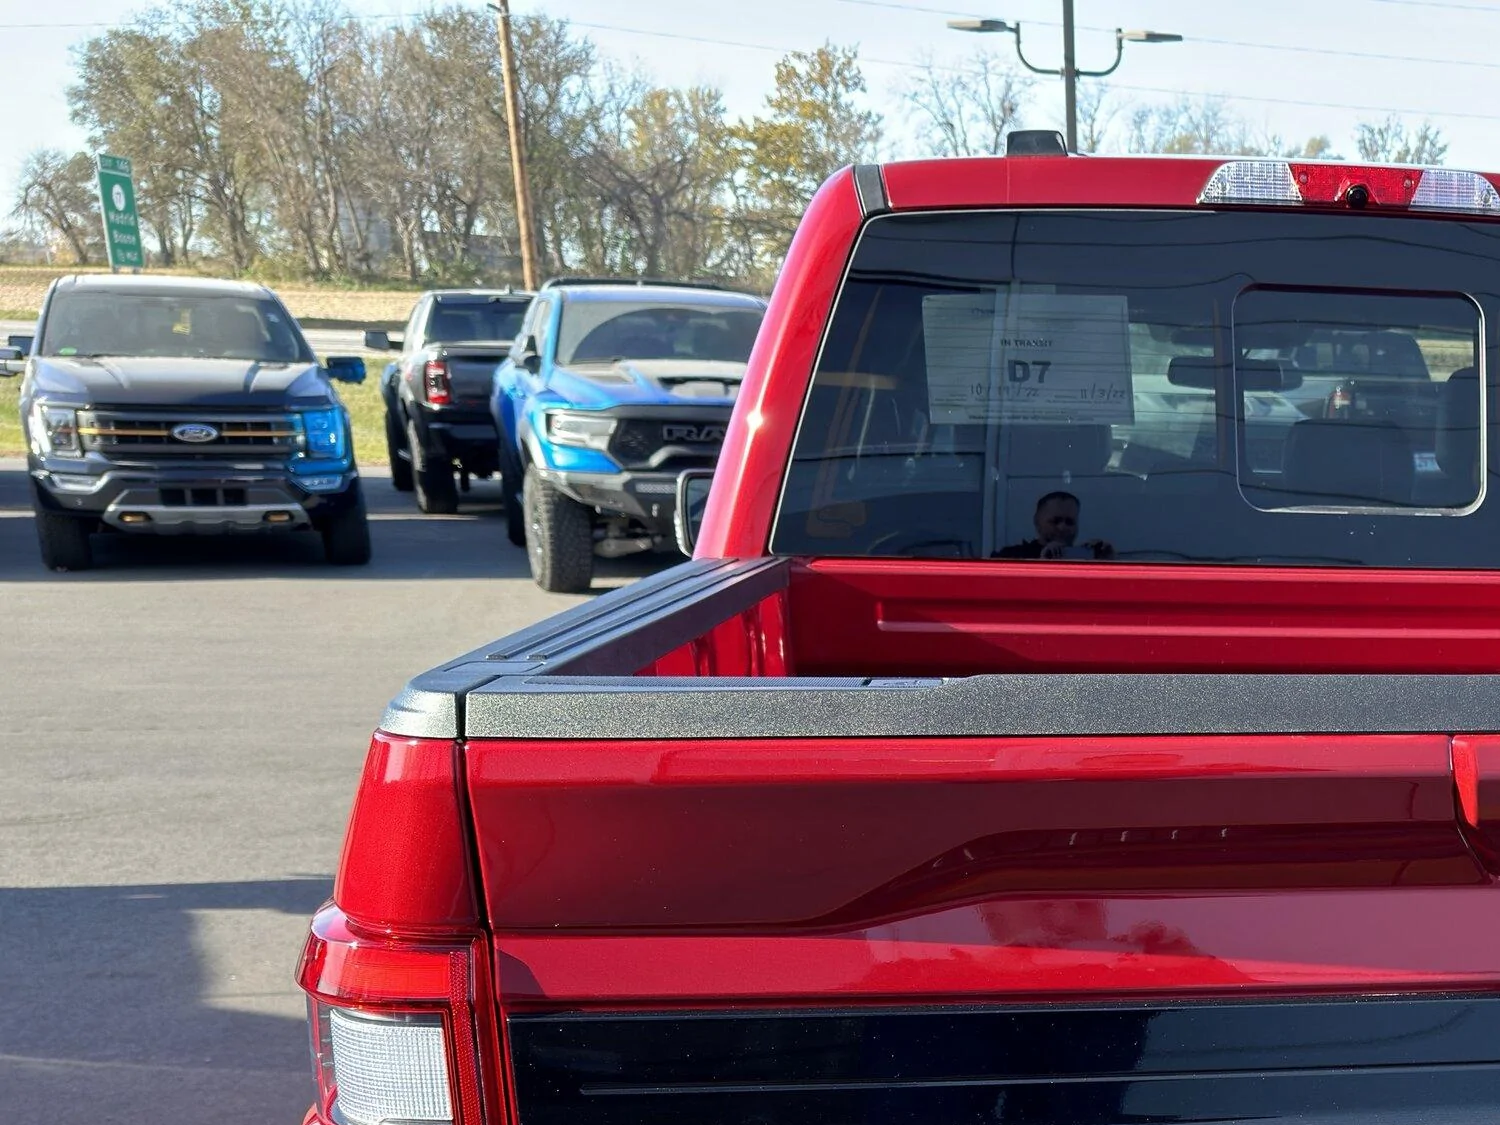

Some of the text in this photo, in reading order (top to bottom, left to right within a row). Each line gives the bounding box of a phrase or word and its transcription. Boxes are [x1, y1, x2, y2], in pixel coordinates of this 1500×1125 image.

[1000, 339, 1053, 348] IN TRANSIT
[1008, 359, 1052, 384] D7
[662, 424, 727, 441] RA
